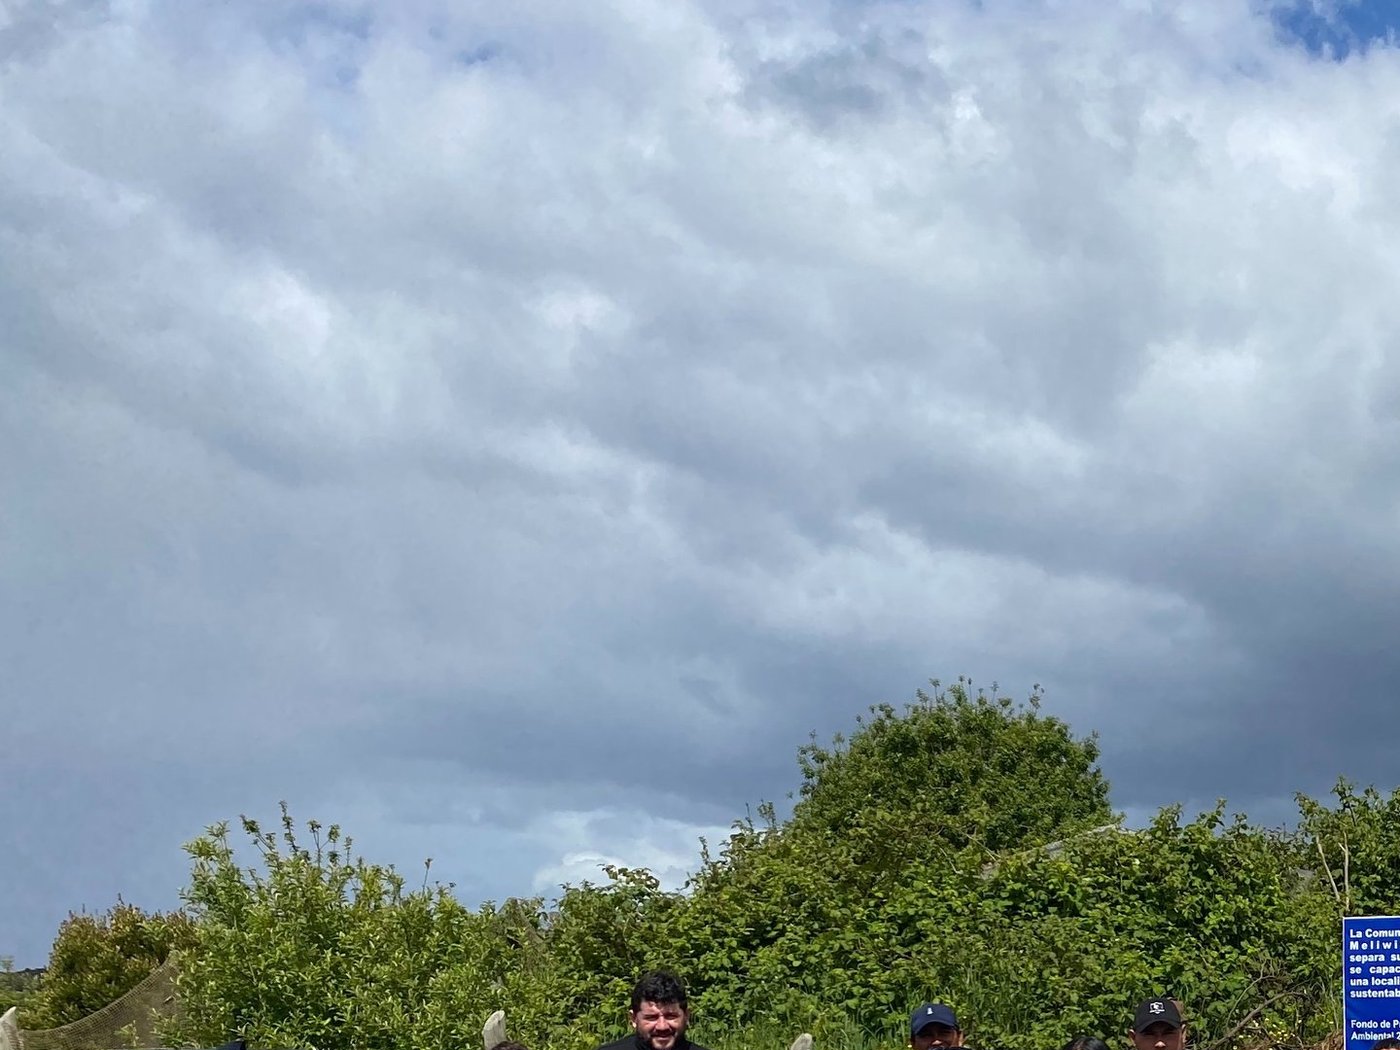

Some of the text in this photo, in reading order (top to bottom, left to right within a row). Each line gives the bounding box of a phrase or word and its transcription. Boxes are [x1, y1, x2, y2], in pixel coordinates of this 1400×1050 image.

[1350, 929, 1363, 938] La
[1349, 954, 1385, 964] separa
[1349, 966, 1362, 974] se
[1350, 978, 1369, 986] una
[1350, 1020, 1379, 1029] Fondo
[1379, 1020, 1391, 1029] de
